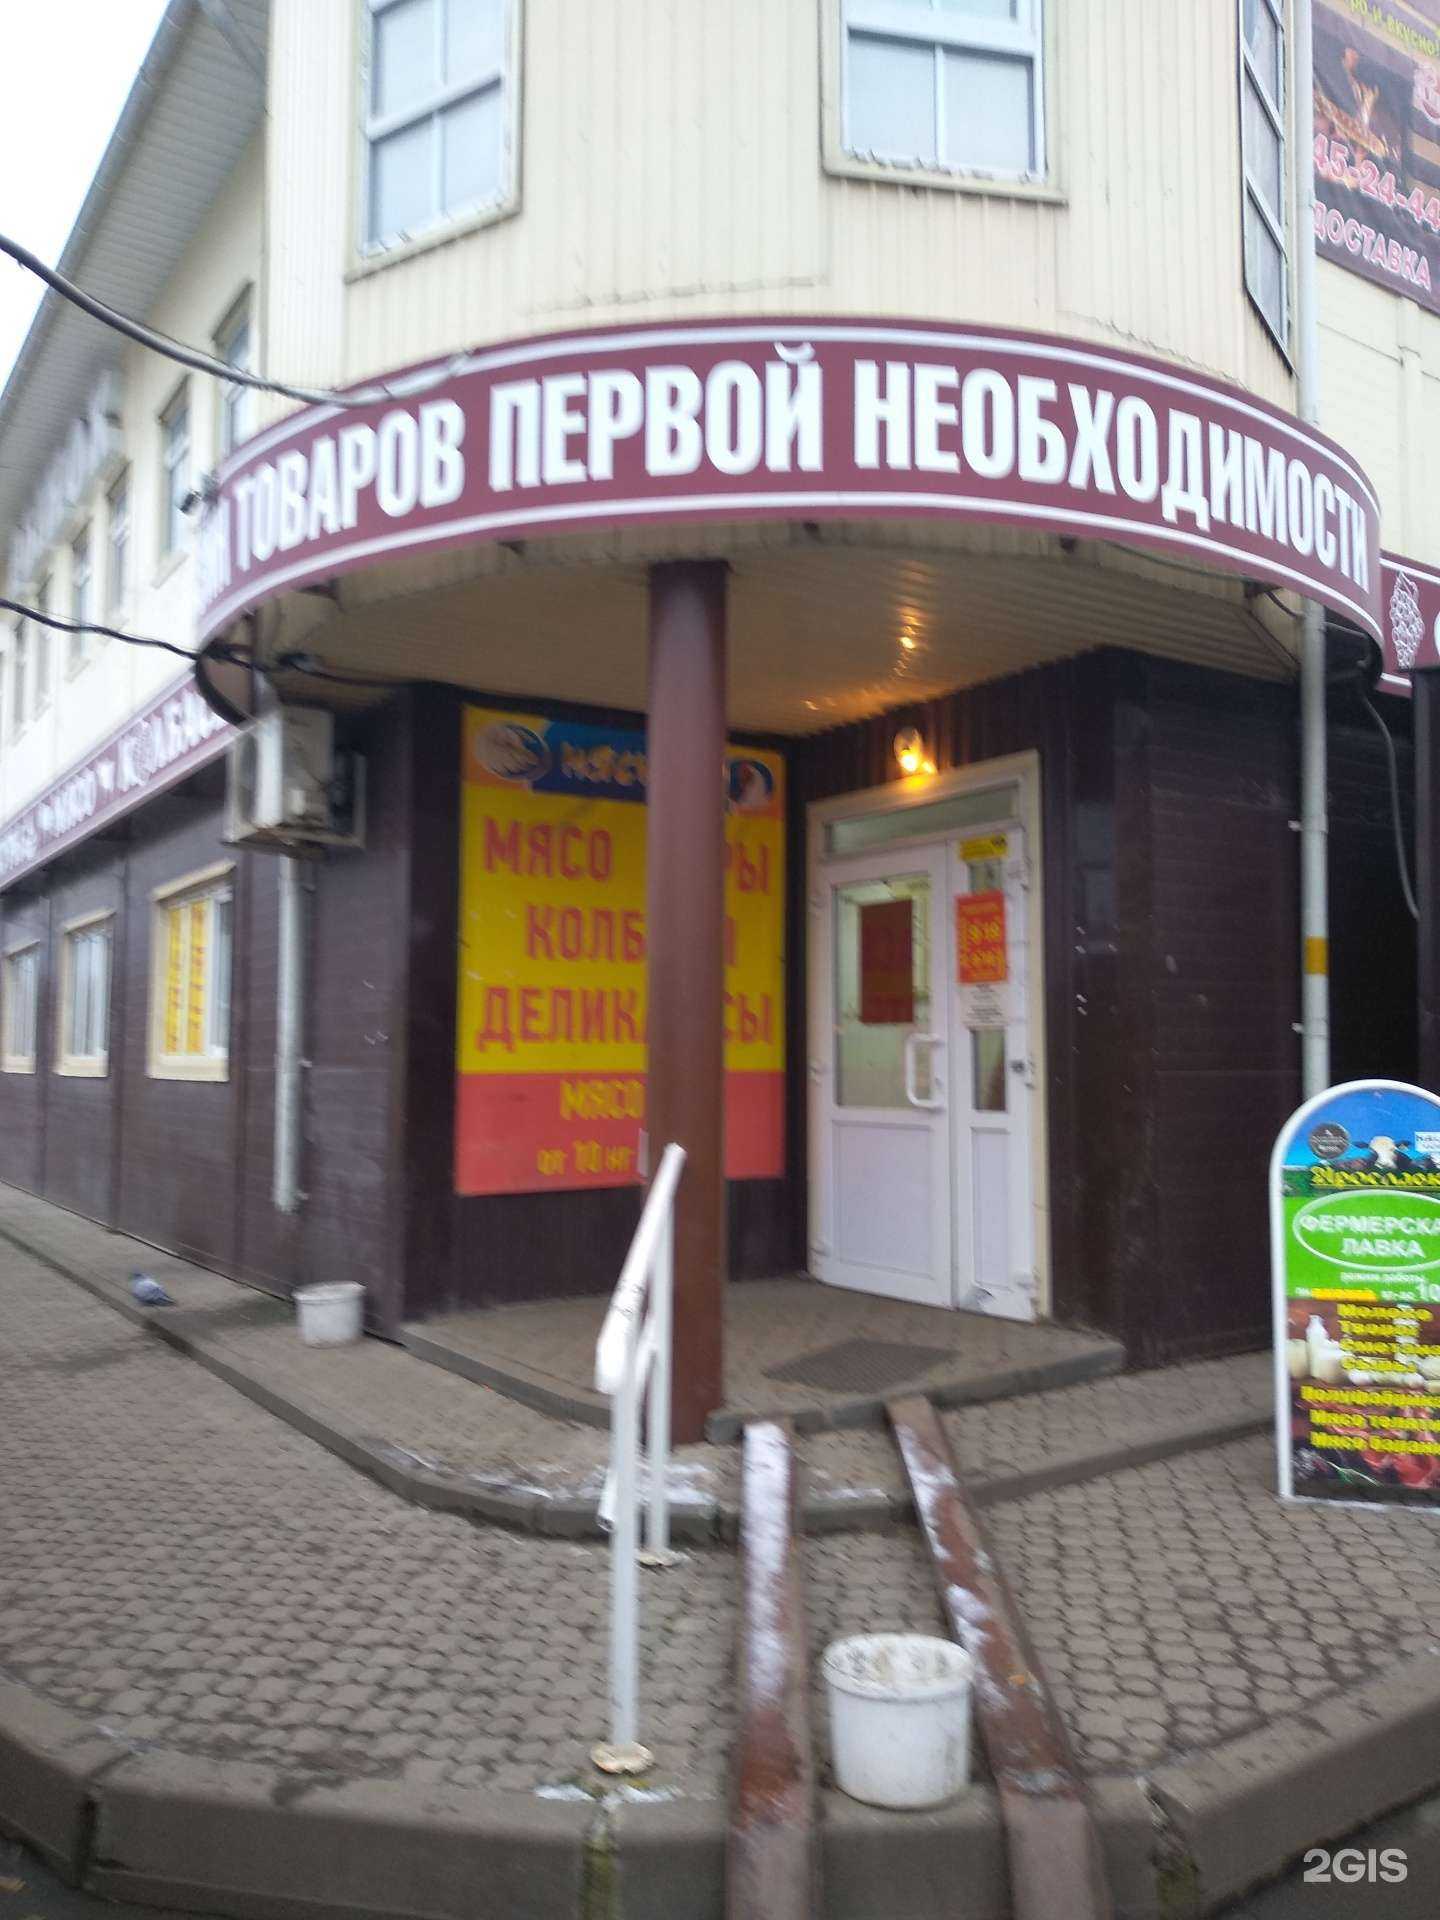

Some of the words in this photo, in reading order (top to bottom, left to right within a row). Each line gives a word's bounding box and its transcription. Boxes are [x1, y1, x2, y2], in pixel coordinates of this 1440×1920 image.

[231, 399, 465, 573] ТОВАРОВ
[488, 341, 823, 492] ПЕРВОЙ
[853, 359, 1370, 594] НЕОБХОДИМОСТИ
[483, 814, 613, 884] МЯСО
